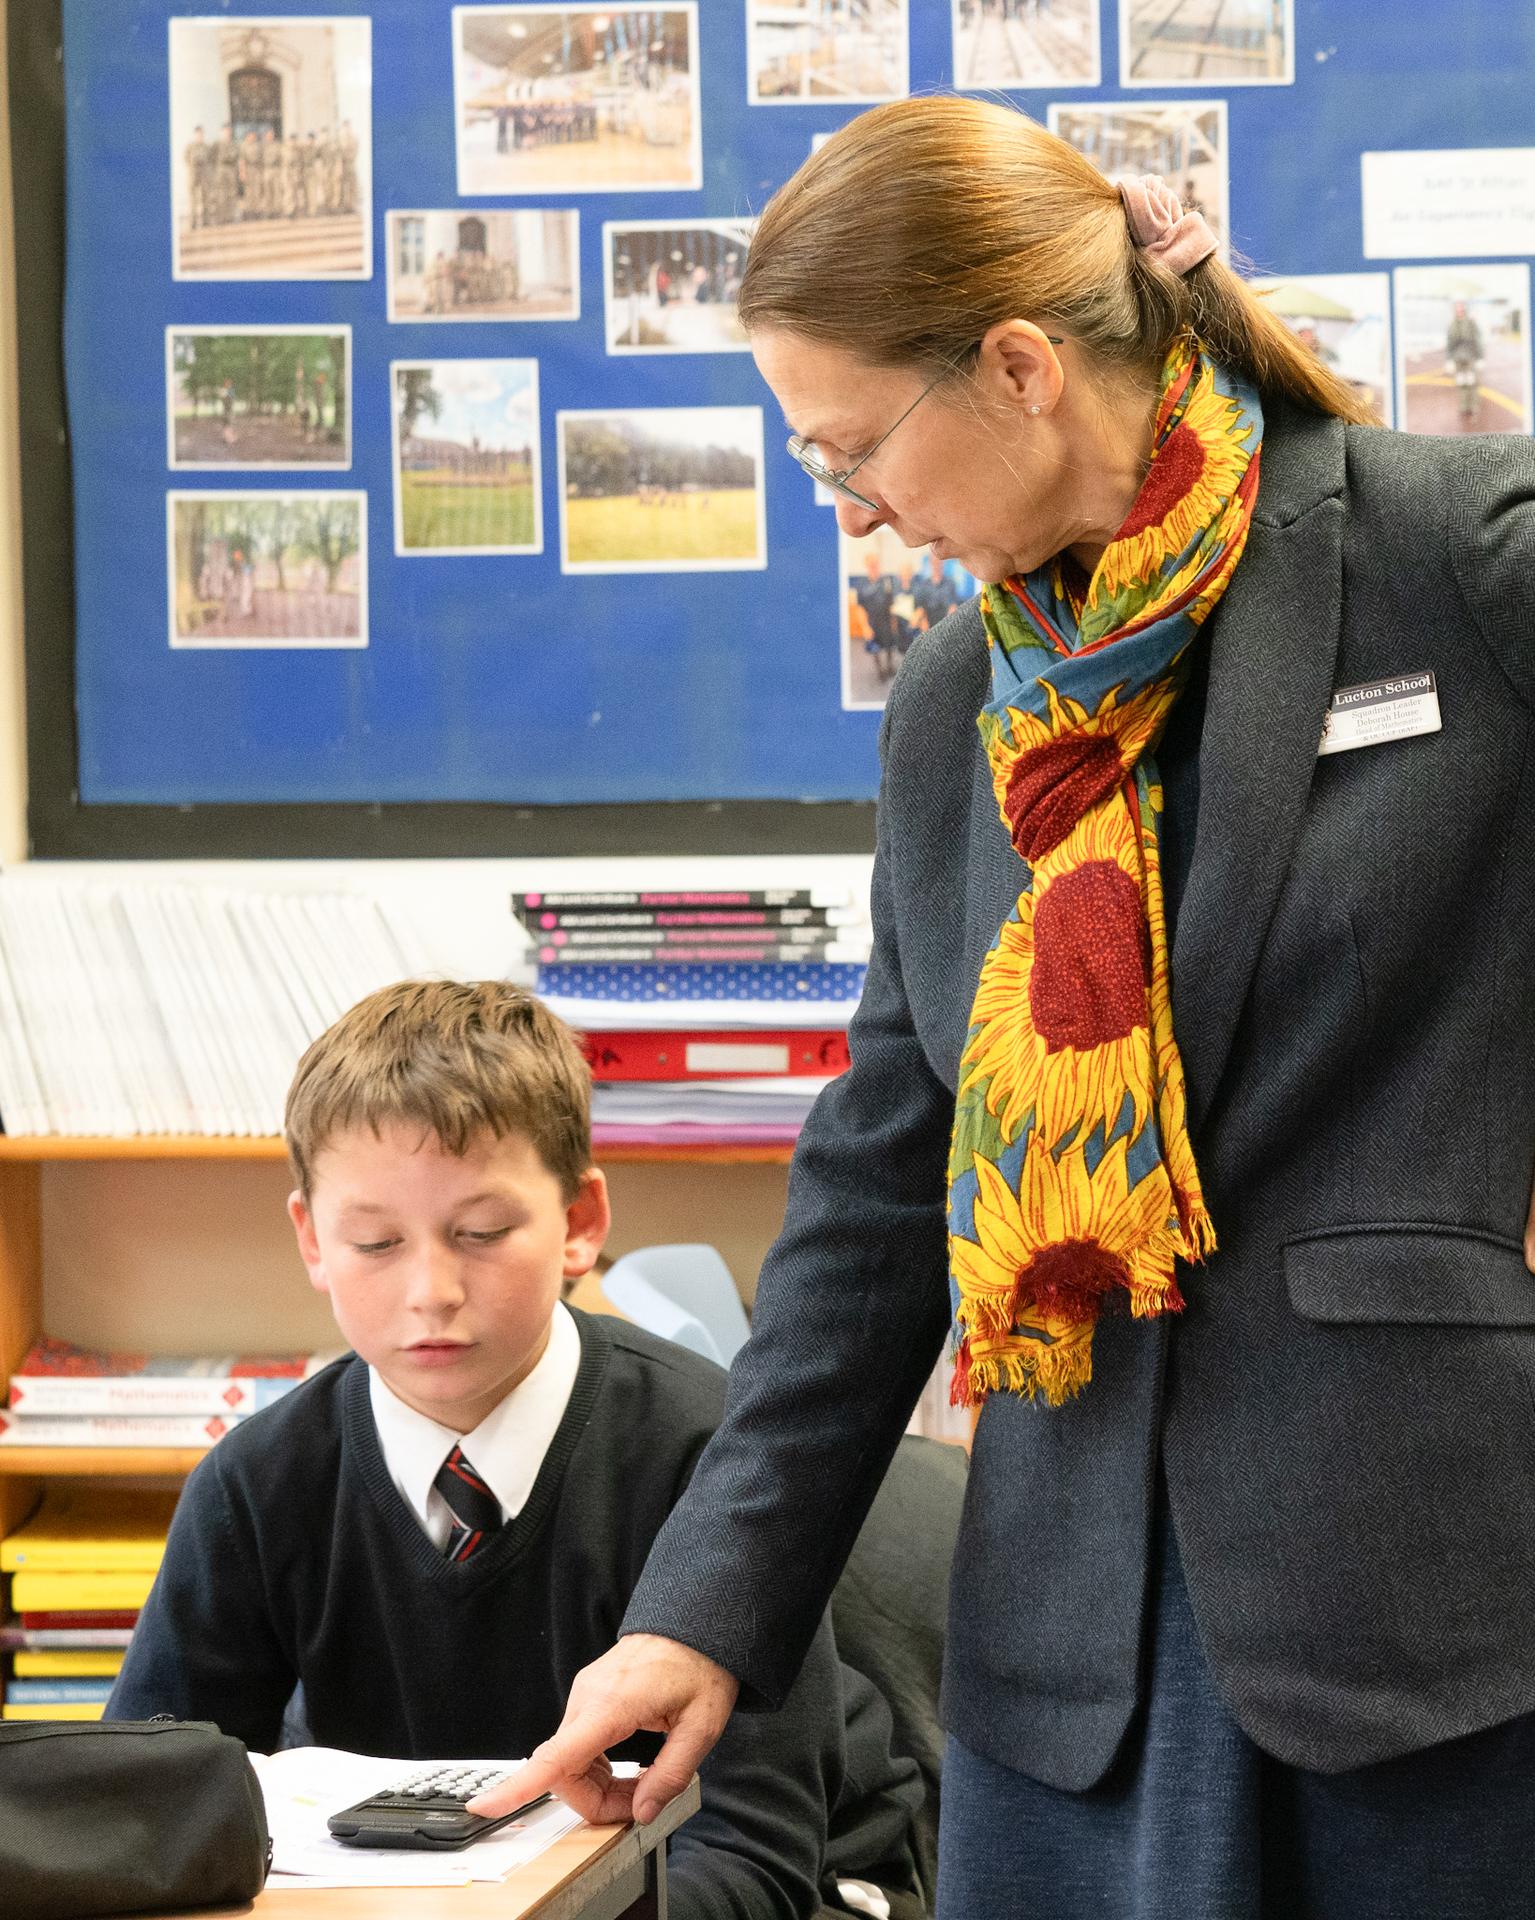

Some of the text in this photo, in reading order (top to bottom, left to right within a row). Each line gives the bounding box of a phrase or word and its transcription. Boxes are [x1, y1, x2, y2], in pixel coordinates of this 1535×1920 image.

[1334, 675, 1432, 706] Lucton School
[1352, 699, 1422, 720] Squadron Leader
[1357, 709, 1419, 728] Deborah House
